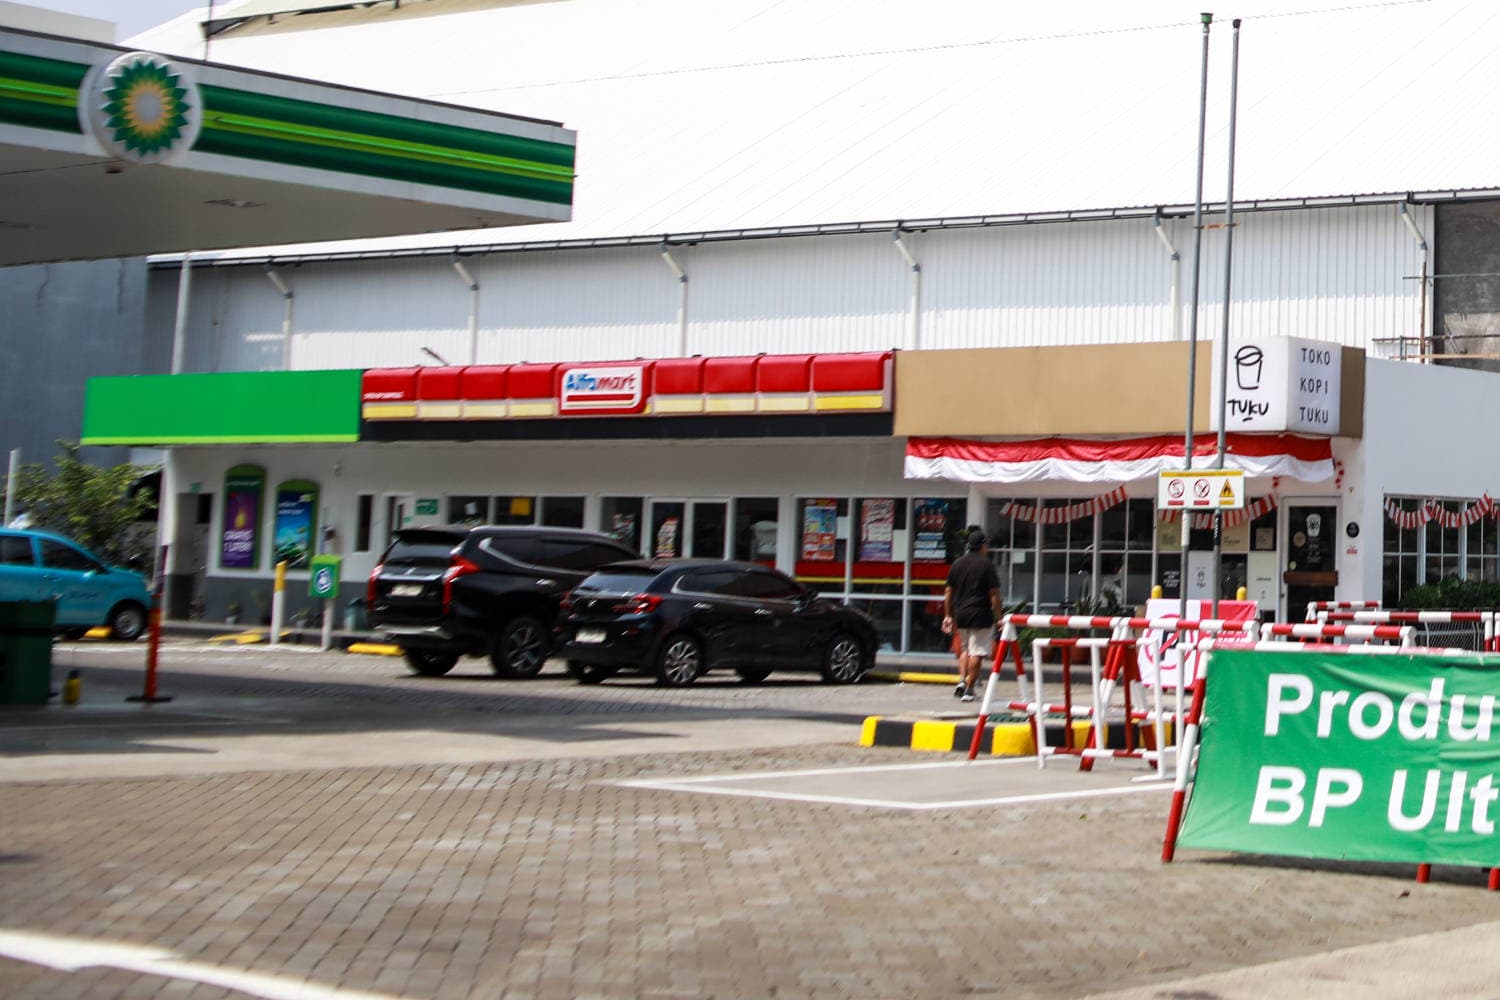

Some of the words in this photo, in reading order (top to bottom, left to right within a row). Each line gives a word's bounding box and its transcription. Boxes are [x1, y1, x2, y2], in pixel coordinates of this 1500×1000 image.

[1301, 347, 1331, 366] TOKO
[1300, 376, 1329, 395] KOPI
[1299, 406, 1329, 424] TUKU
[1248, 764, 1364, 829] BP
